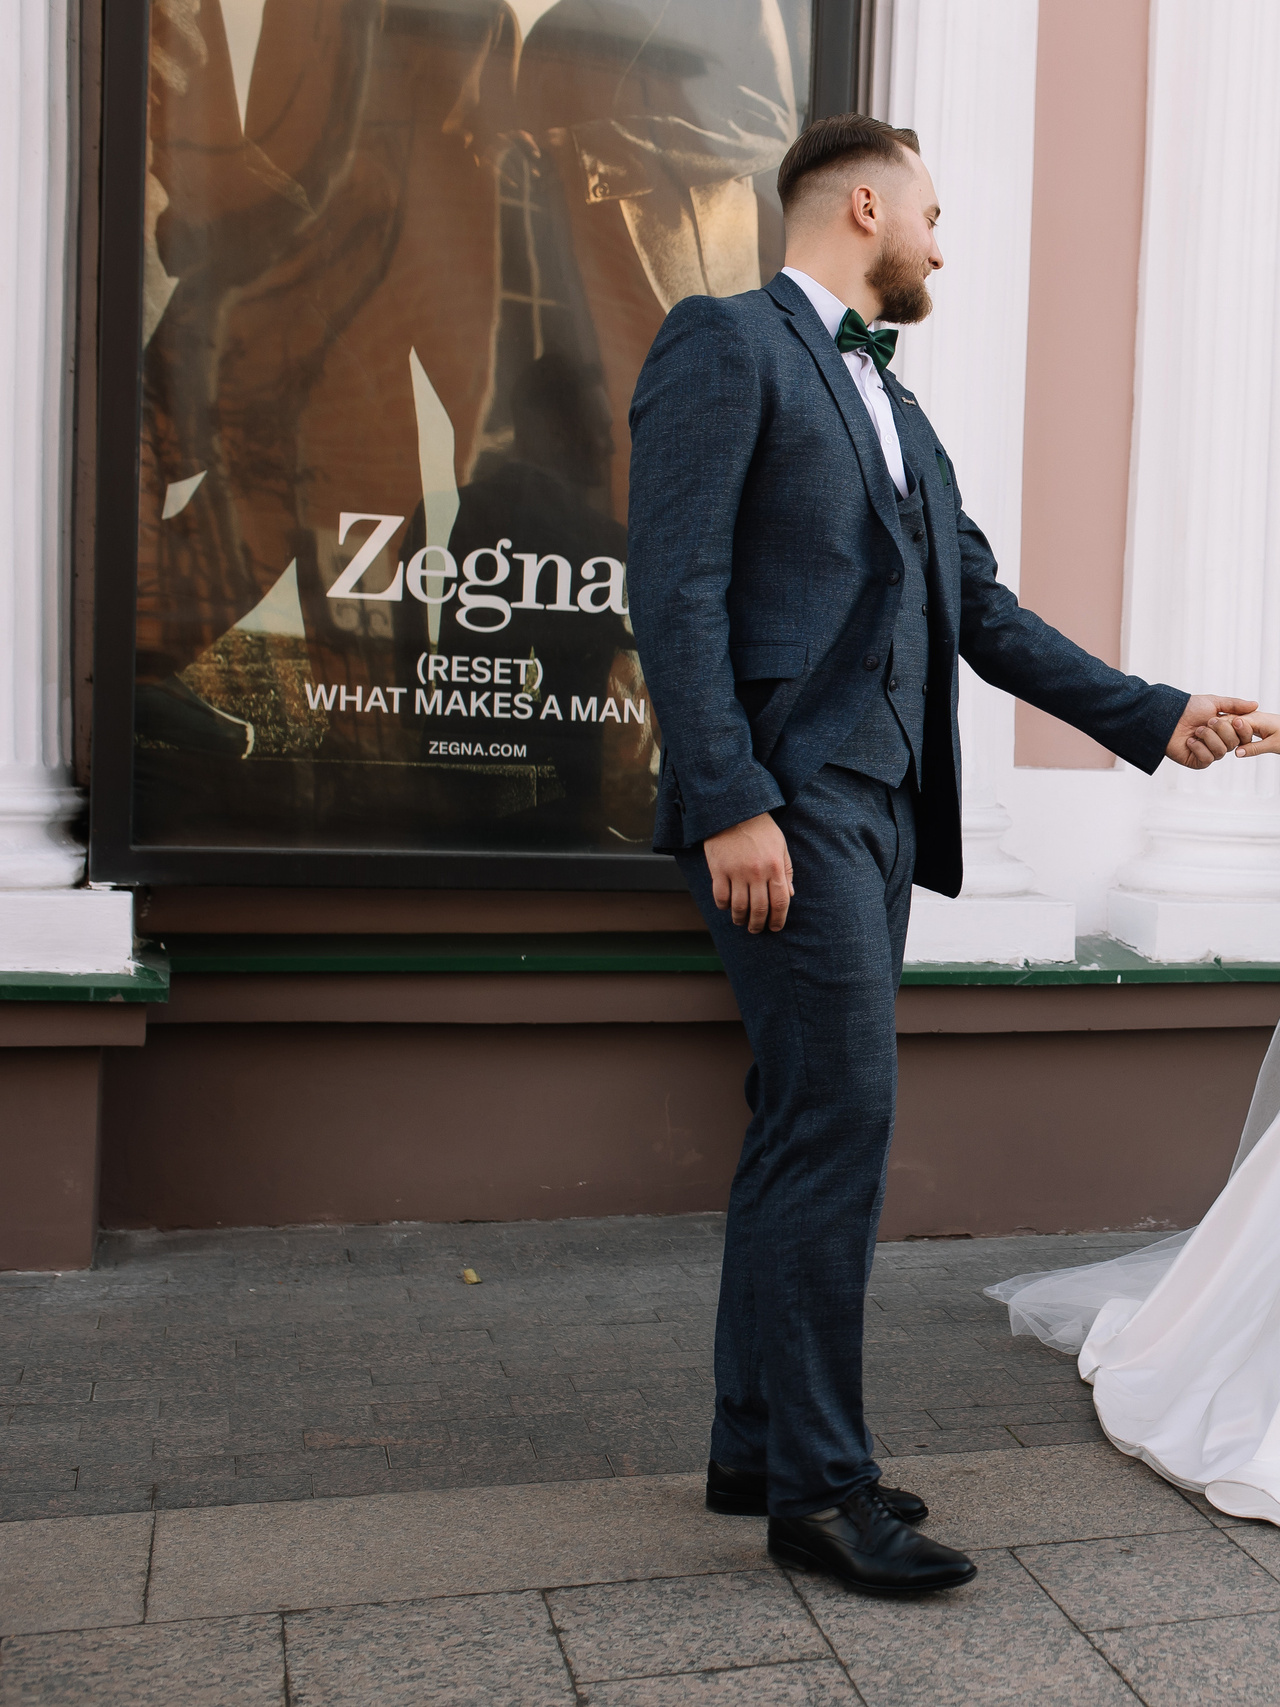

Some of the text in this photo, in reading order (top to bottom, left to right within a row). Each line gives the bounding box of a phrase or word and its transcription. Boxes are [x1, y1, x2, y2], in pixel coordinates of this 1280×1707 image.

[326, 512, 629, 633] Zegna
[417, 652, 543, 690] (RESET)
[305, 683, 645, 724] WHAT MAKES A MAN
[429, 741, 527, 757] ZEGNA.COM
